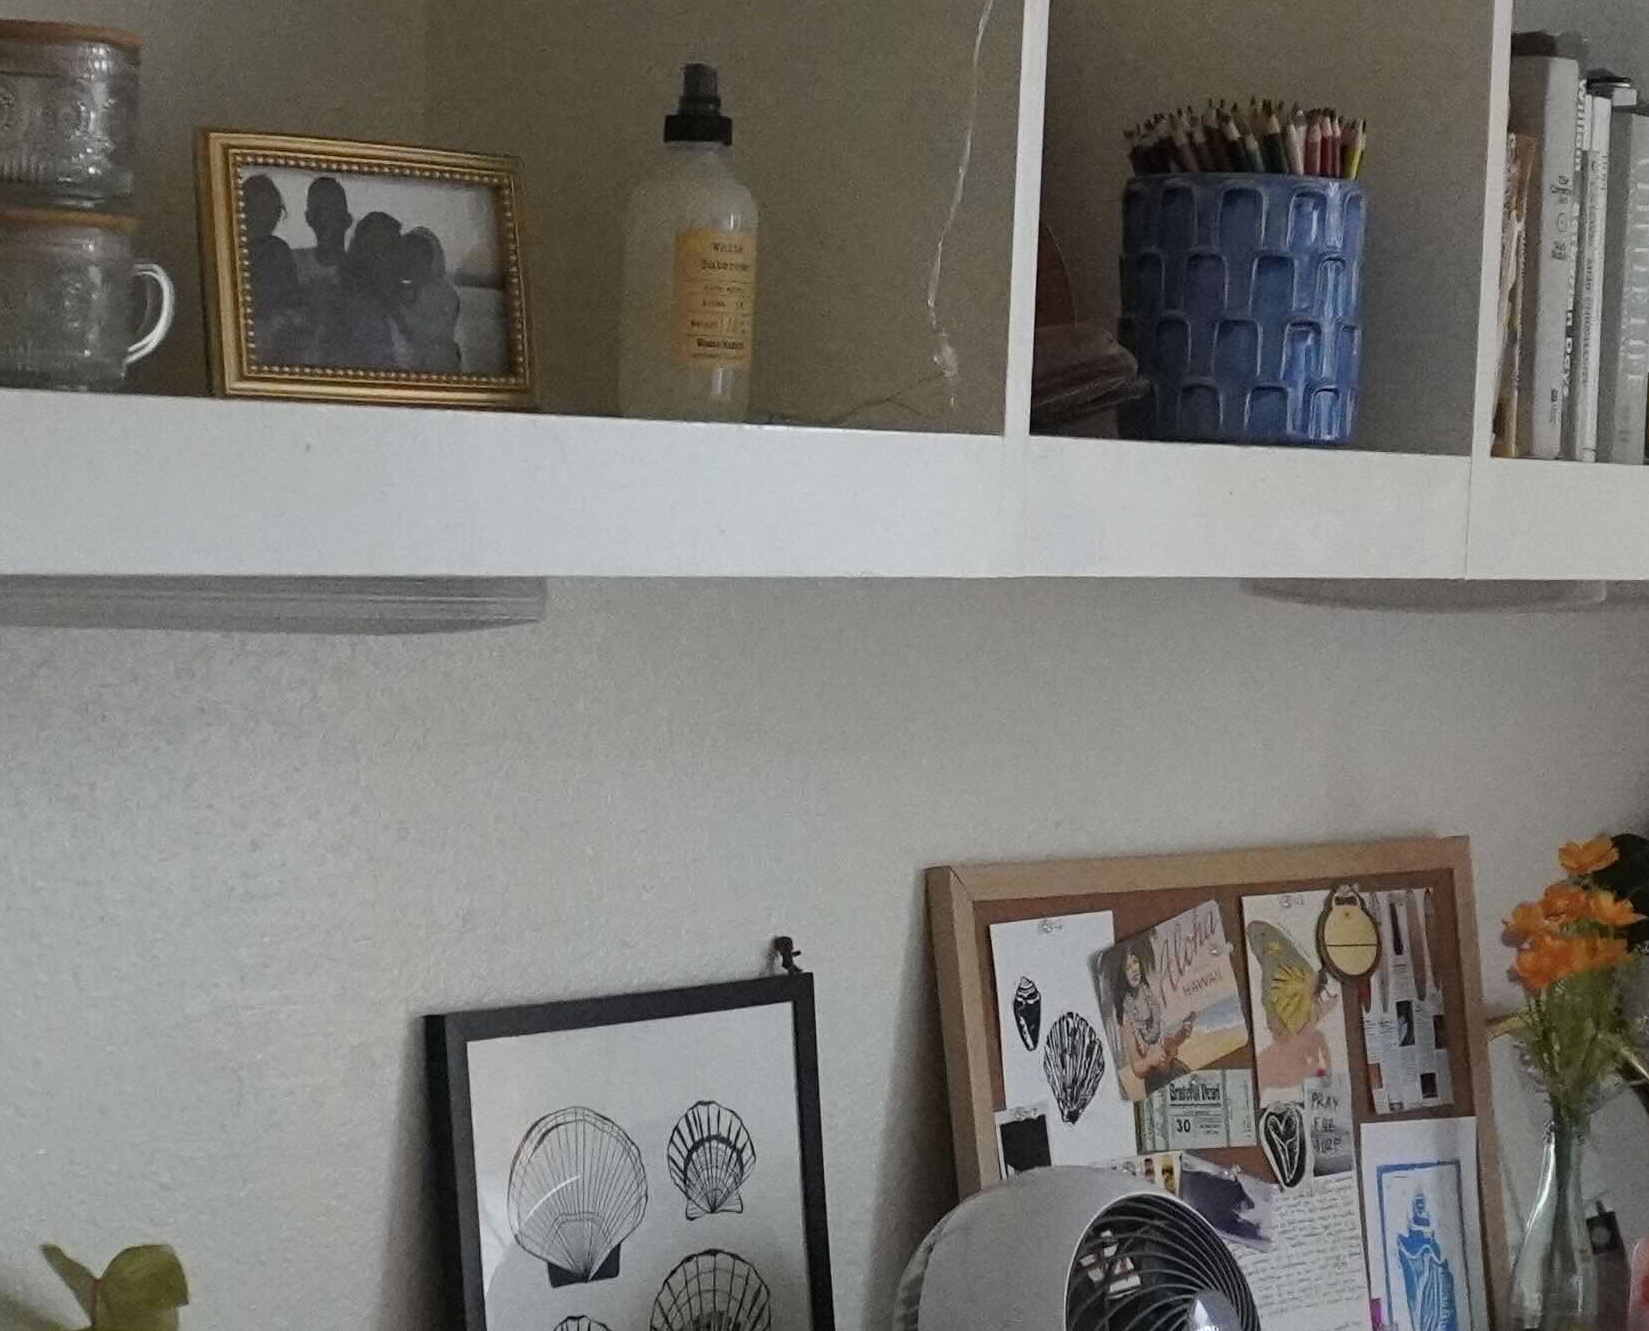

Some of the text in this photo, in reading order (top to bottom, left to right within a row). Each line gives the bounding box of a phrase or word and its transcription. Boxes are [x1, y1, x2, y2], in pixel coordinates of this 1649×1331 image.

[1627, 317, 1648, 392] LIFE
[1159, 909, 1219, 1007] Aloha
[1176, 1118, 1191, 1133] 30
